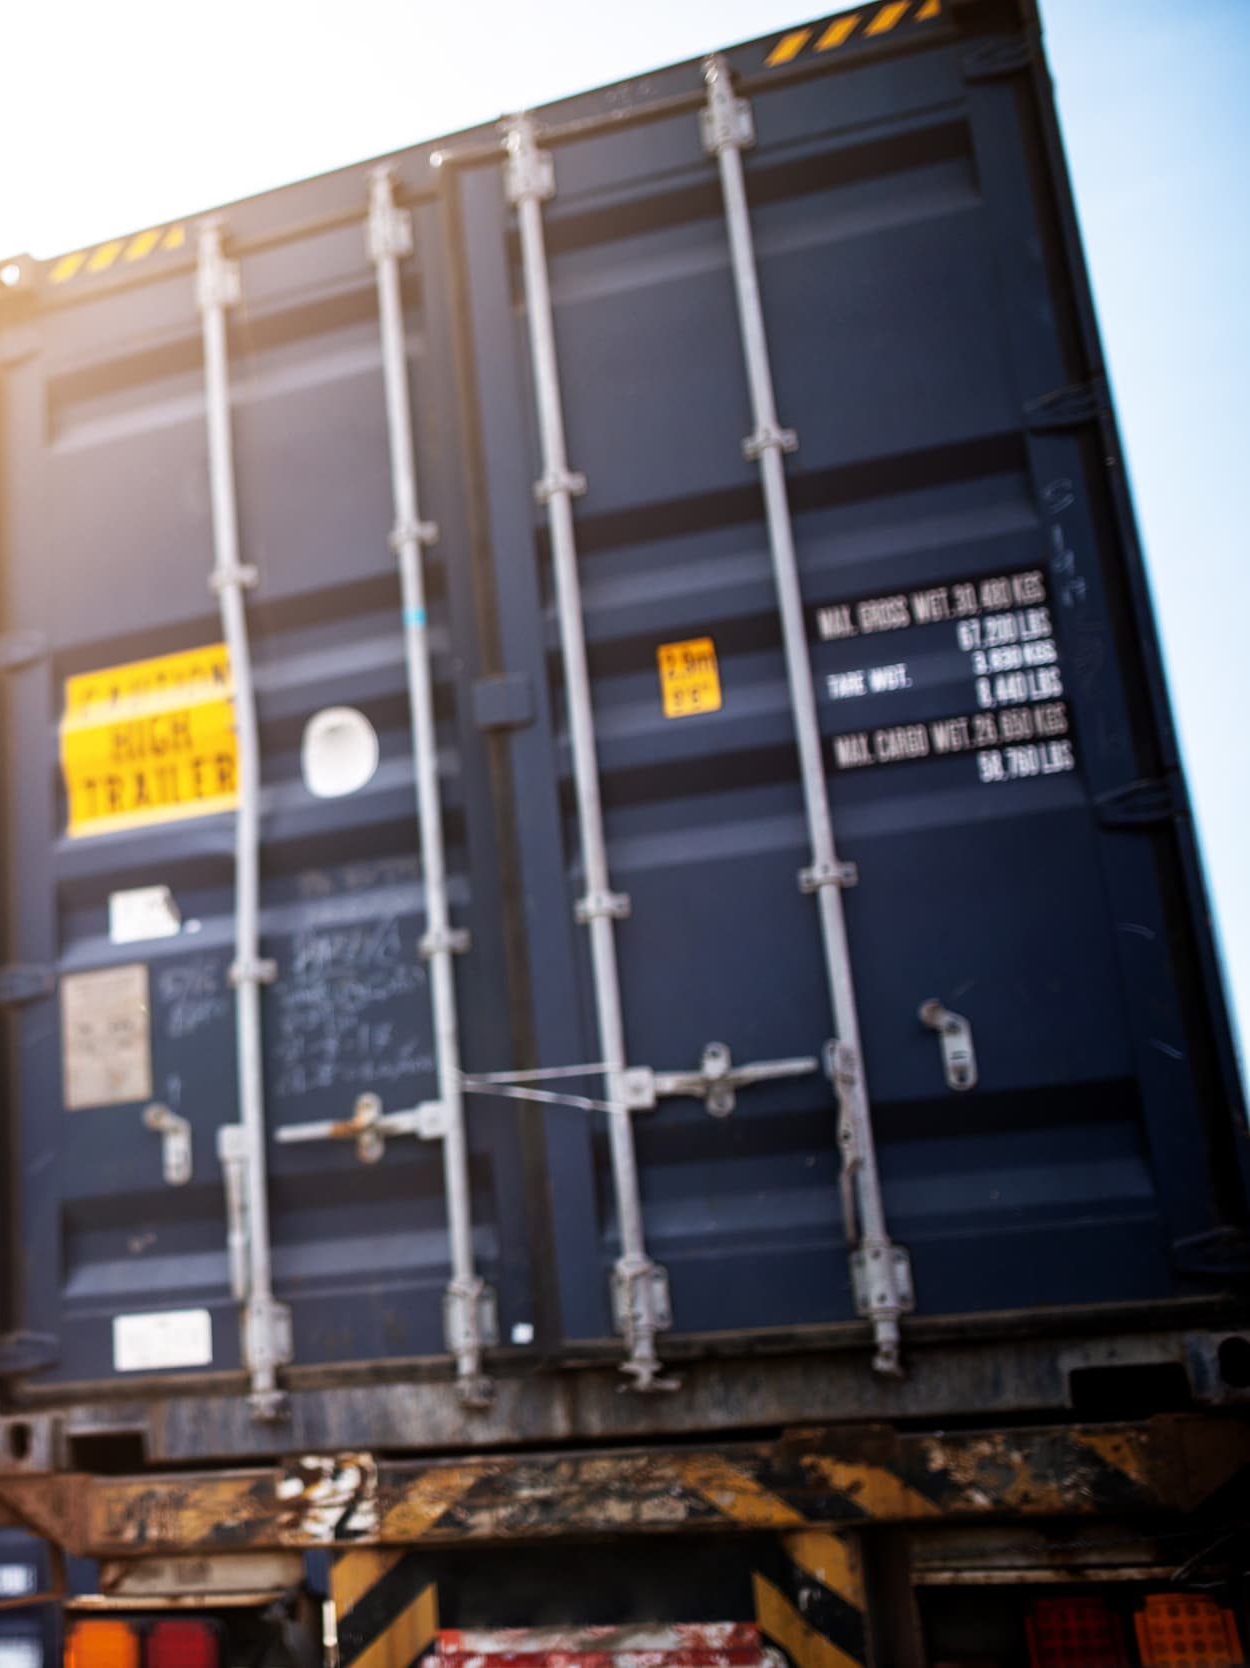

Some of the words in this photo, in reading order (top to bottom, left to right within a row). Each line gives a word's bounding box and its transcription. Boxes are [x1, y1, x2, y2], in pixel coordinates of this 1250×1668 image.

[1017, 607, 1053, 641] LBS
[827, 670, 868, 700] TARE
[1028, 665, 1063, 700] LBS
[111, 709, 193, 765] HIGH
[873, 723, 930, 762] CARGO
[1039, 739, 1075, 775] LBS
[83, 752, 236, 818] TRAILER
